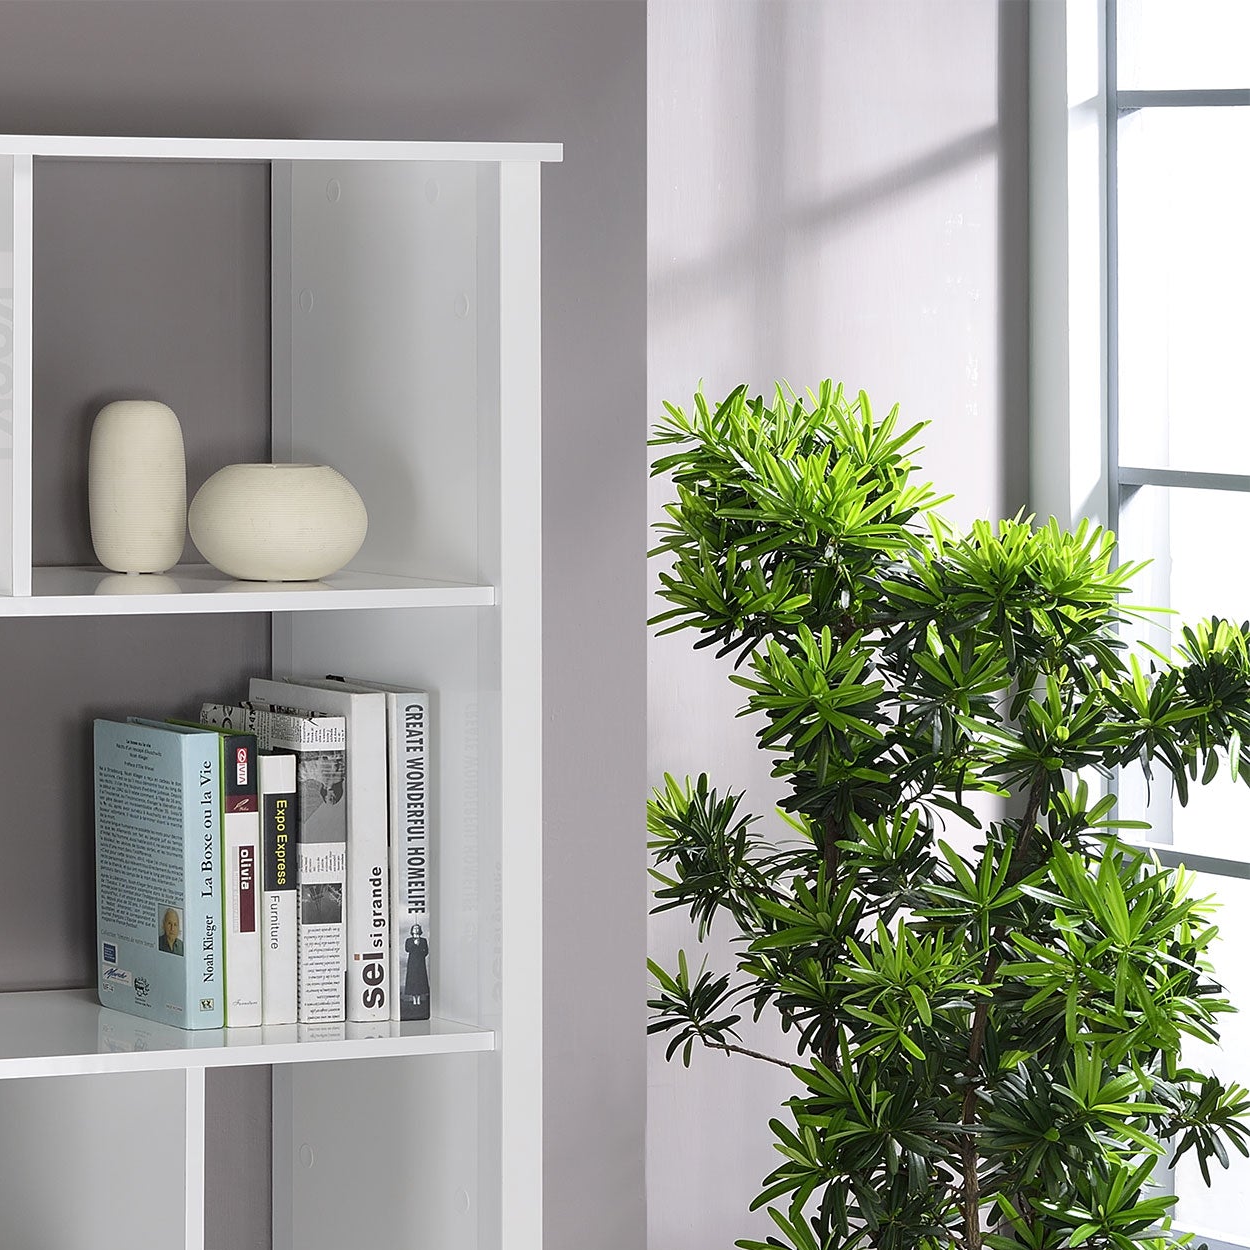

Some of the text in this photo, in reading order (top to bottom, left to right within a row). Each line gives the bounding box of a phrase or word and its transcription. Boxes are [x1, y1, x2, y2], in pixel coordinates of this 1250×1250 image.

[199, 760, 213, 898] La Boxe ou la Vie
[274, 799, 288, 885] Expo Express
[404, 703, 426, 914] CREATE WONDERFUL HOMELIFE
[240, 849, 253, 890] olivia
[202, 915, 217, 983] Noah Klieger
[270, 895, 280, 950] Furniture
[353, 866, 386, 1009] sei si grande
